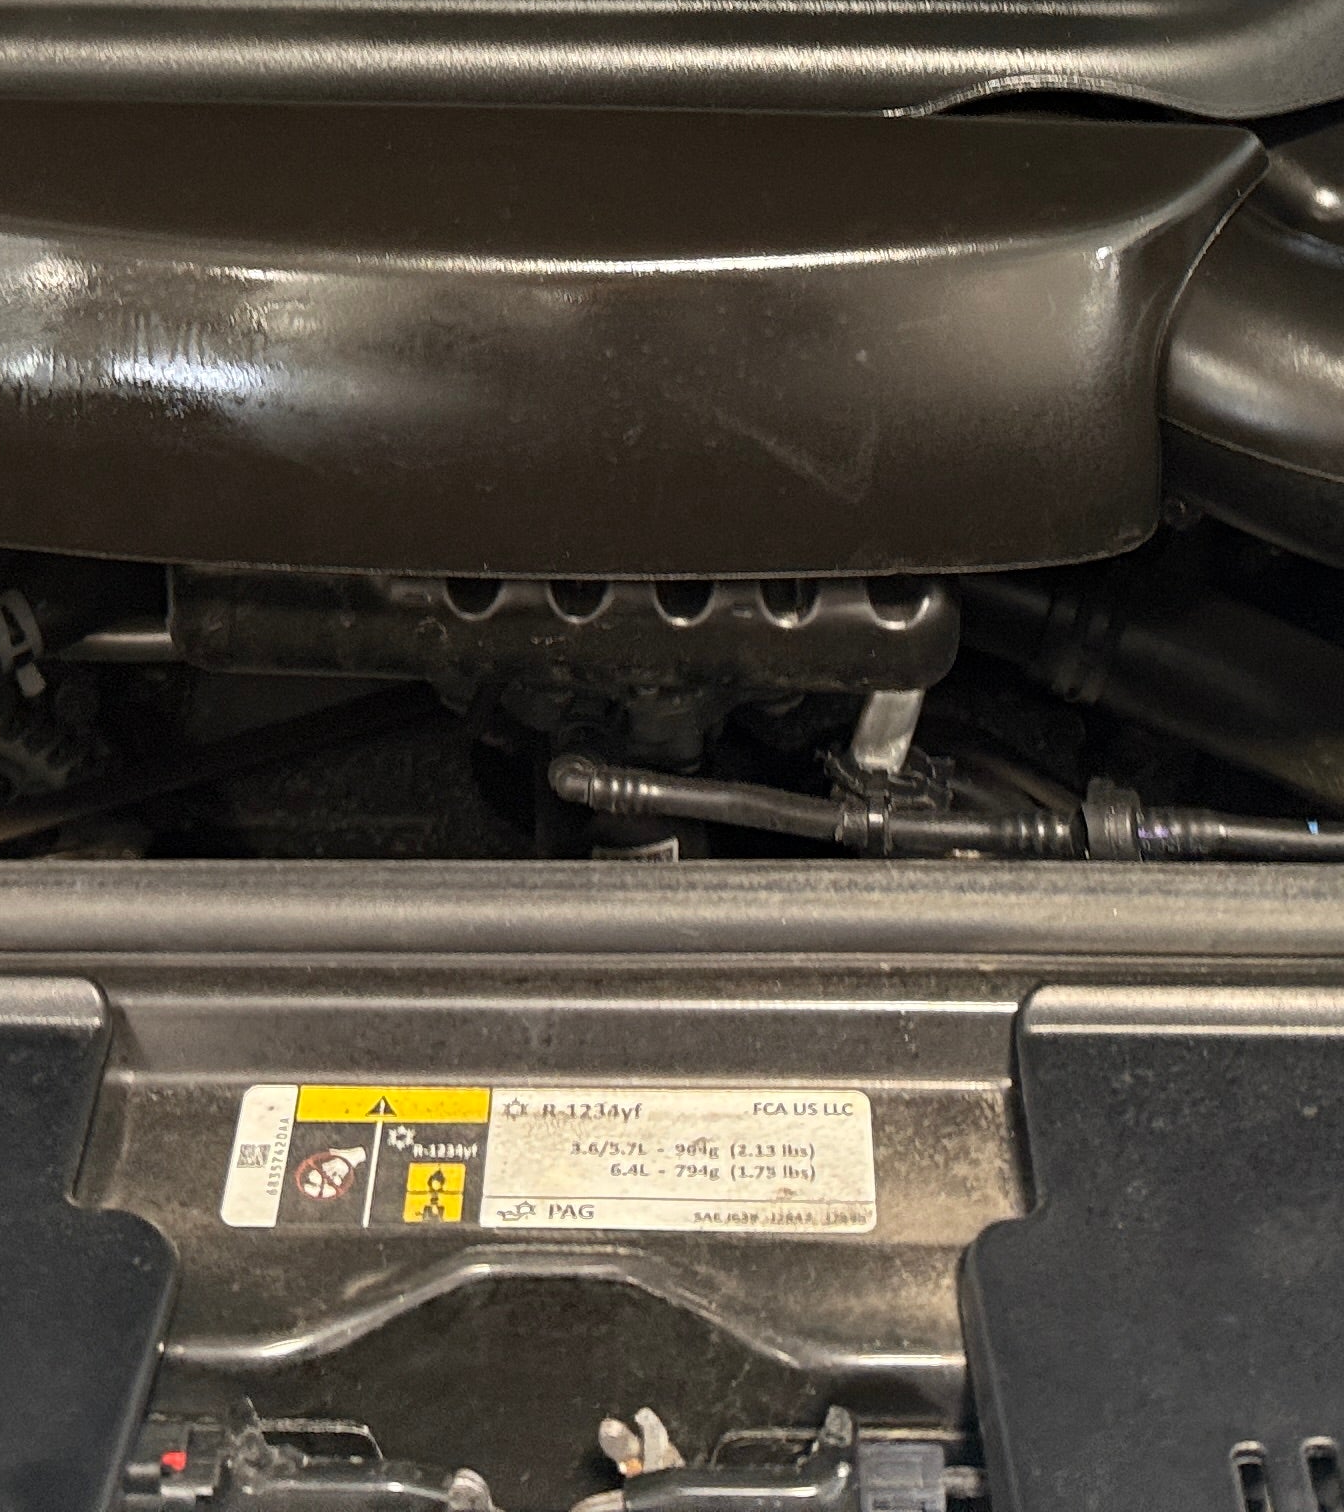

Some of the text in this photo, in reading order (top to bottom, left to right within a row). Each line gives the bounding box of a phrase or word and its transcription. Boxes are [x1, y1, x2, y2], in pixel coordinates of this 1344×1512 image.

[752, 1102, 854, 1116] FCA US LLC
[782, 1142, 816, 1161] lbs)
[610, 1163, 650, 1177] 6.4L
[782, 1164, 816, 1183] lbs)
[548, 1203, 595, 1220] PAG
